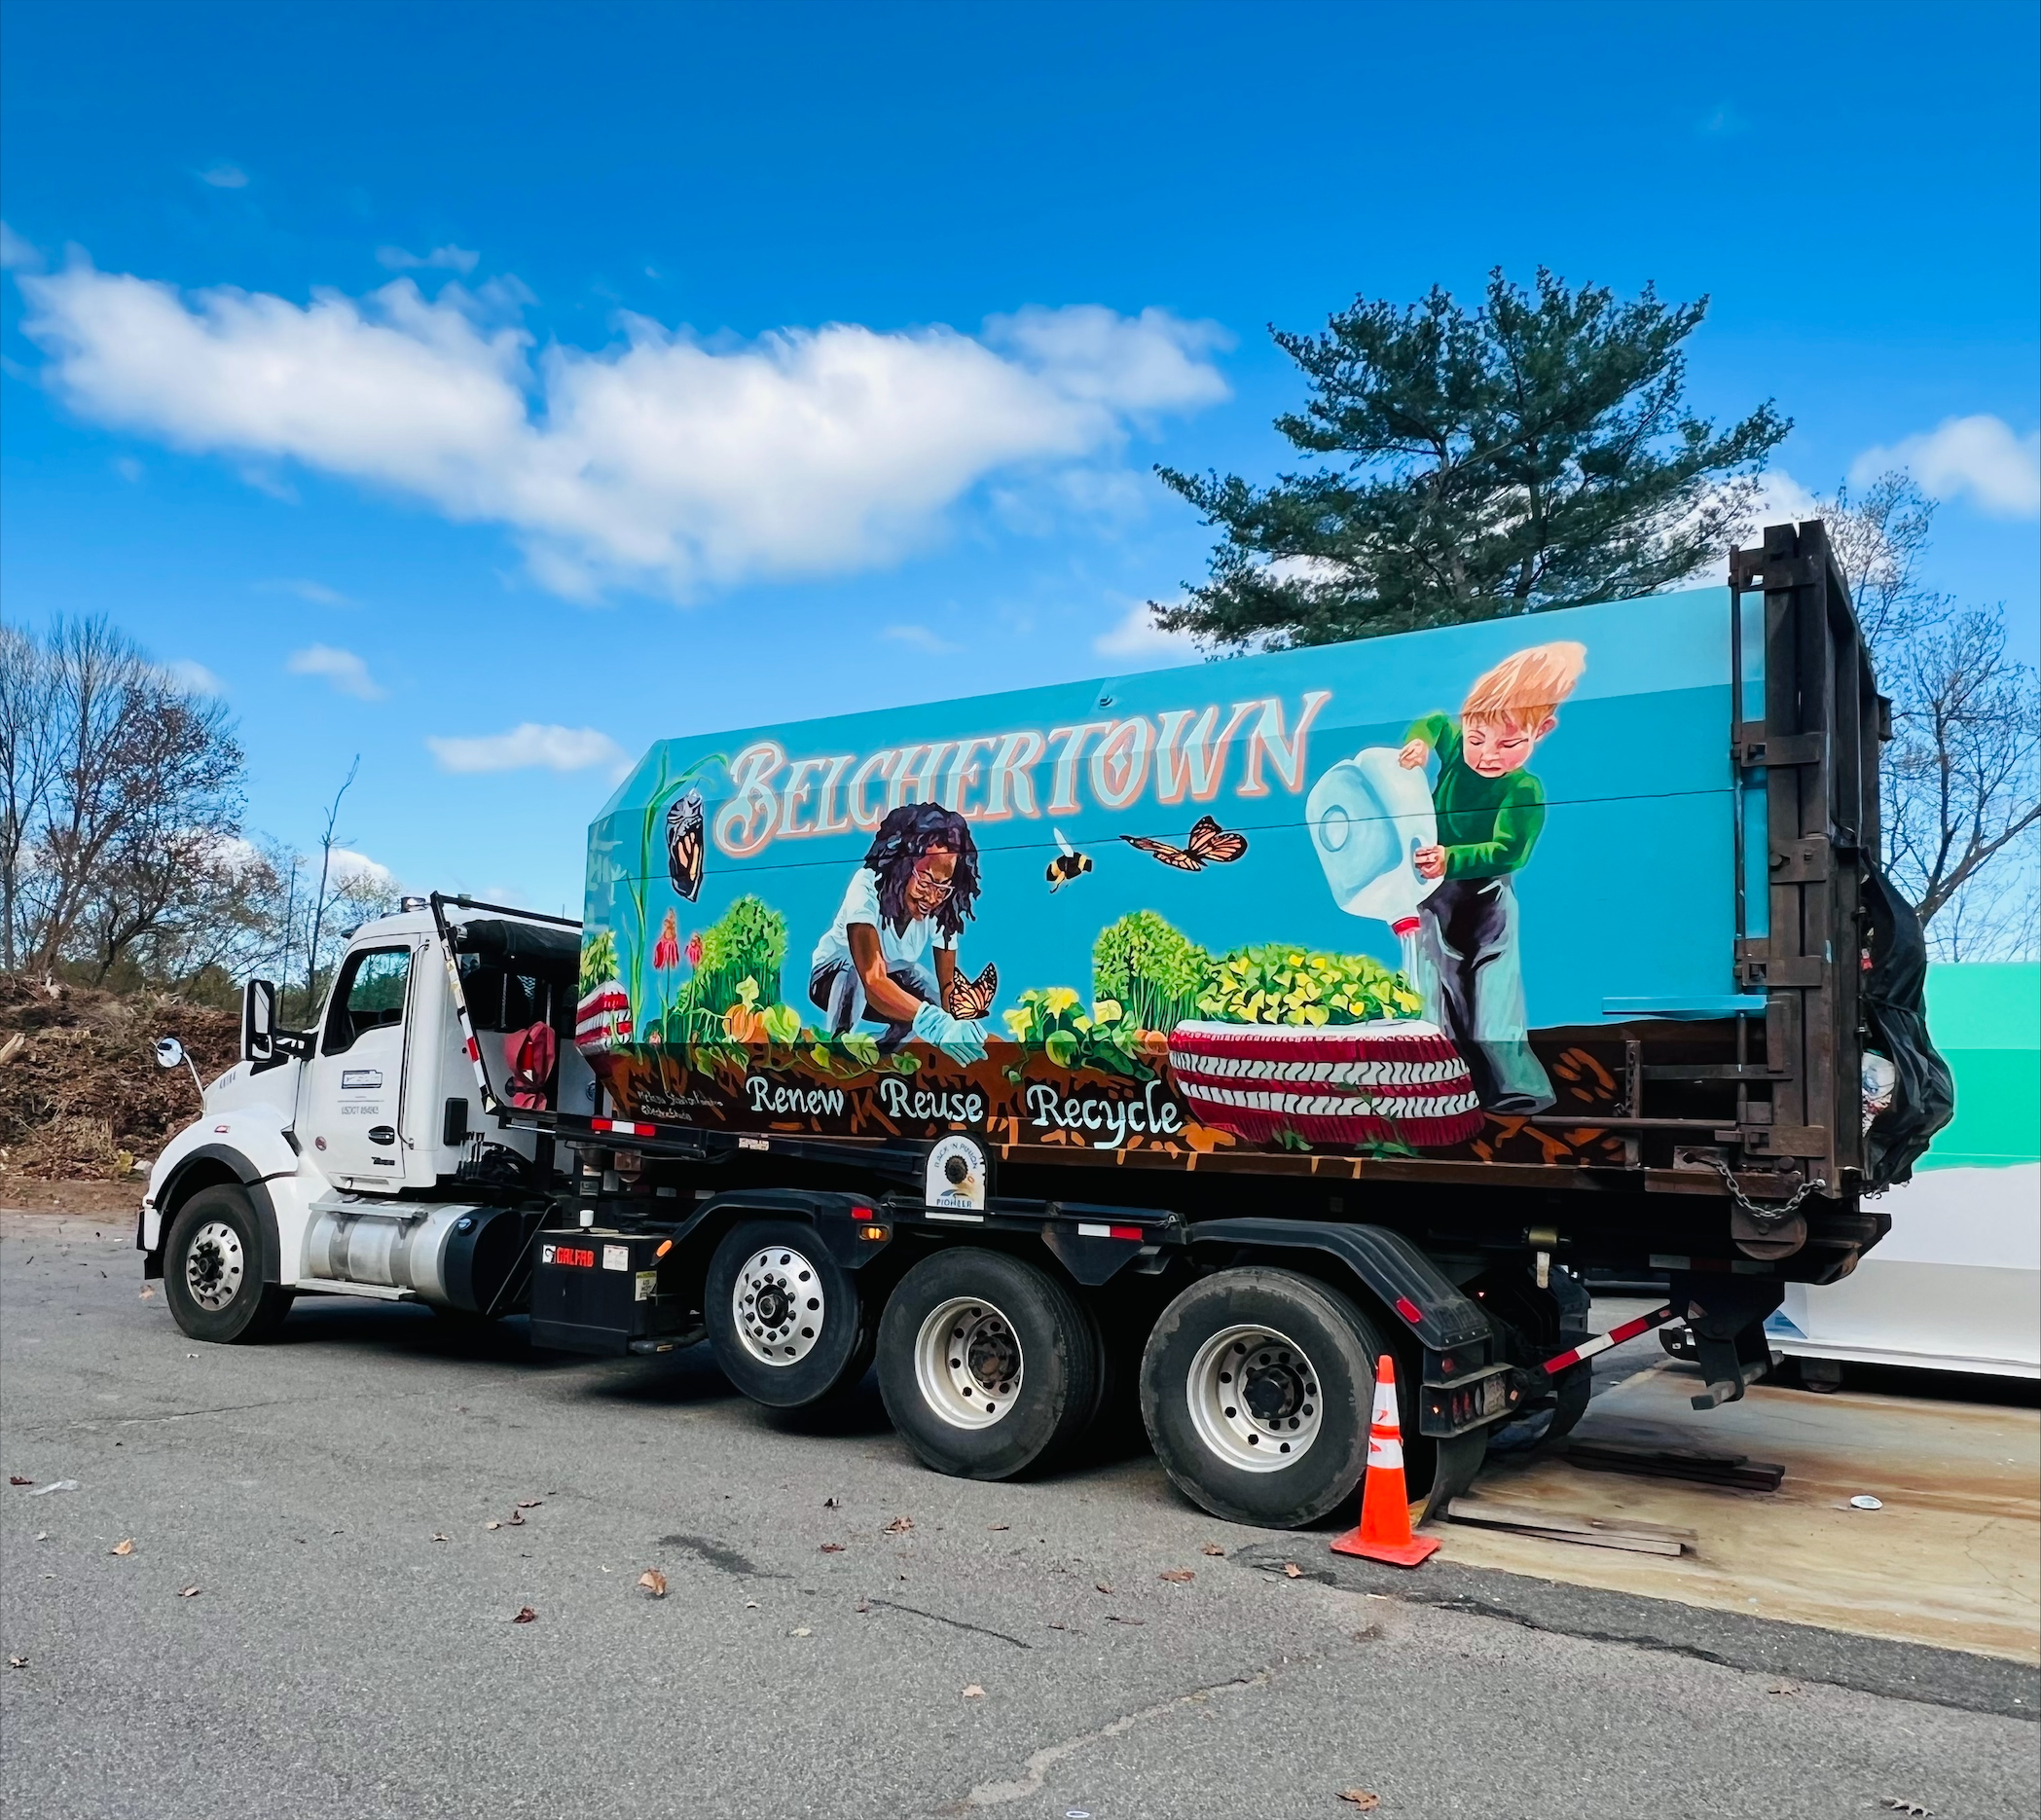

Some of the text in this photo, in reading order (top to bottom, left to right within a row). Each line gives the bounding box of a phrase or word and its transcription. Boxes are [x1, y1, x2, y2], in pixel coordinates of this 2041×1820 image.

[713, 690, 1330, 857] BELCHERTOWN
[746, 1075, 1184, 1150] Renew Reuse Recycle
[936, 1198, 972, 1208] PIONEER
